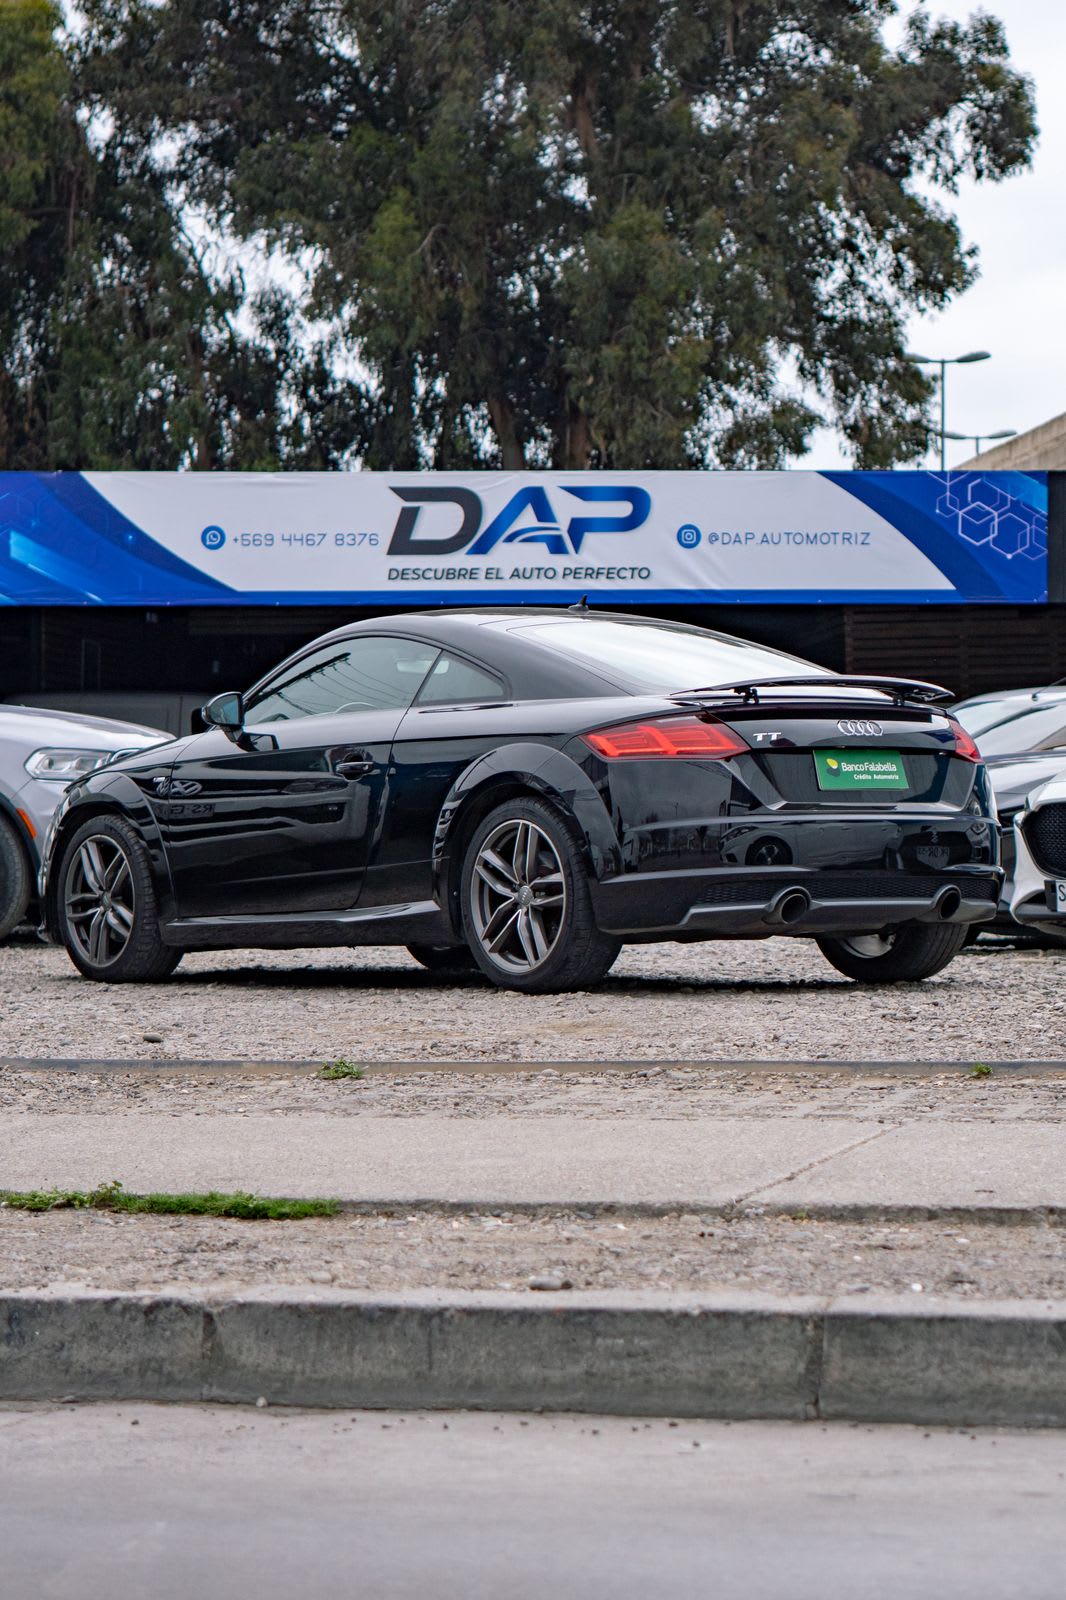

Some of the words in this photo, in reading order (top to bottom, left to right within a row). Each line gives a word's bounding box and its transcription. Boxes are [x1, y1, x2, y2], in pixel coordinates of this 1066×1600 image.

[386, 485, 651, 556] DAP
[233, 533, 275, 546] +569
[282, 533, 326, 546] 4467
[335, 533, 379, 546] 8376
[708, 532, 870, 545] @DAP.AUTOMOTRIZ
[388, 568, 480, 581] DESCUBRE
[484, 567, 504, 581] EL
[510, 567, 557, 580] AUTO
[562, 566, 651, 580] PERFECTO
[753, 732, 782, 741] TT
